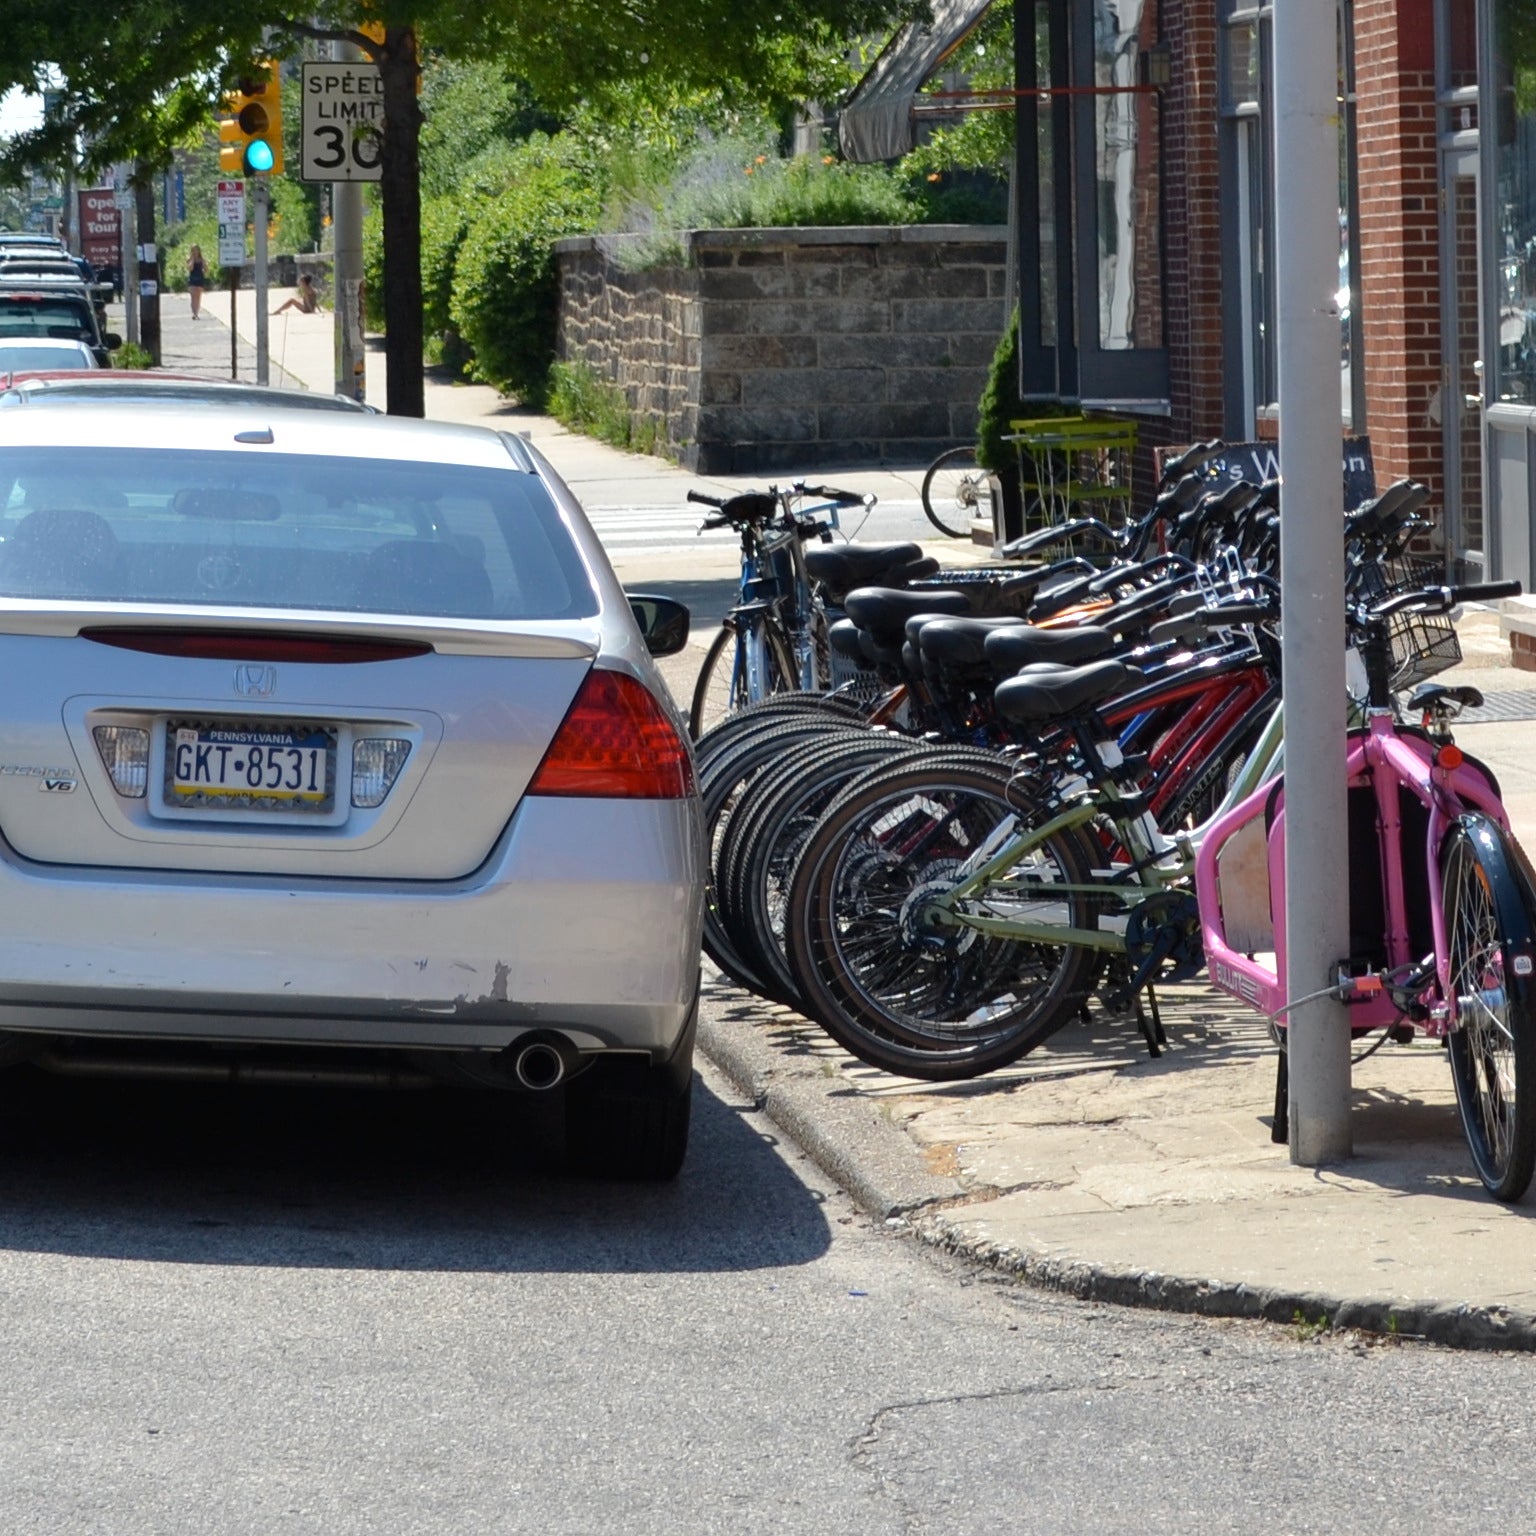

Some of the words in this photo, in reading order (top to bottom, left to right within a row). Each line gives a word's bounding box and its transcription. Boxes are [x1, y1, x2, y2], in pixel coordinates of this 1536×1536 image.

[318, 101, 379, 119] LIMIT
[312, 125, 384, 169] 30
[87, 198, 114, 210] Ope
[96, 212, 115, 222] for
[87, 222, 118, 233] Tour
[210, 730, 294, 745] PENNSYLVANIA
[44, 779, 73, 791] V6
